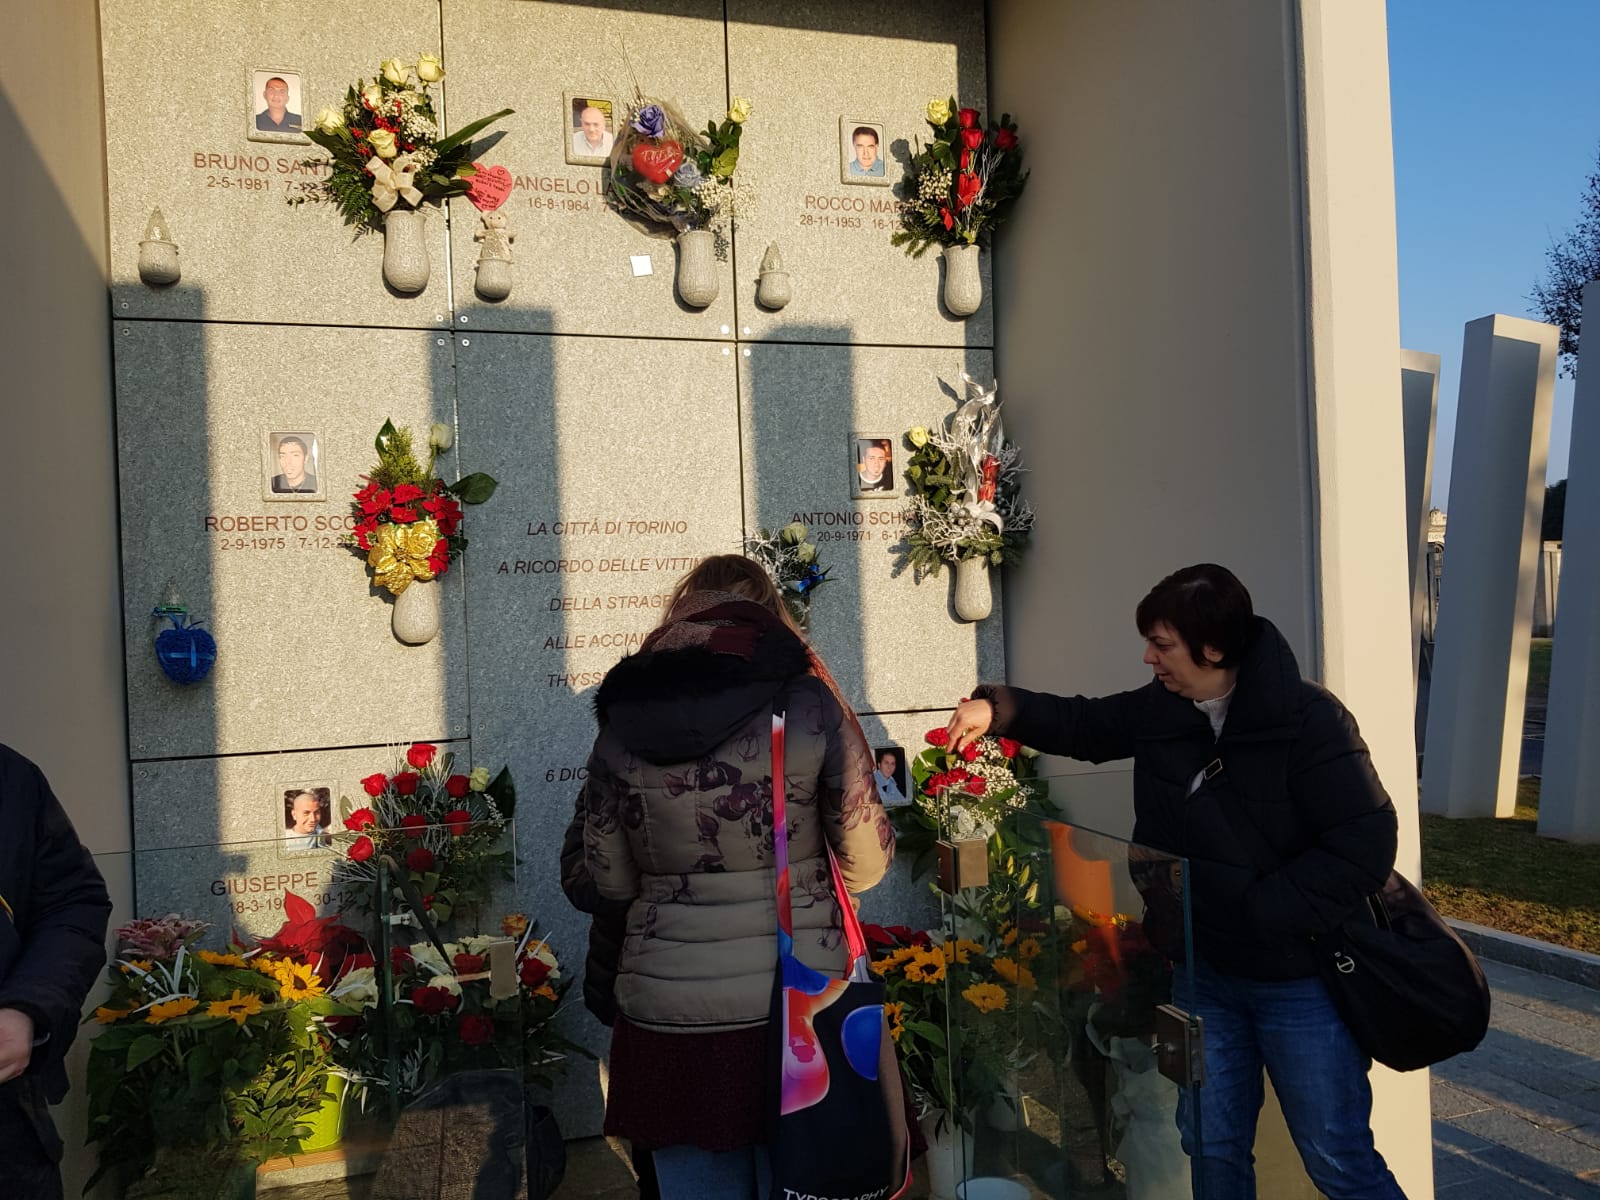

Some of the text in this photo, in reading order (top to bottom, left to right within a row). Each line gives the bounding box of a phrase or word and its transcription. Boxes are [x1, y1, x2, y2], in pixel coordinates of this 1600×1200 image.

[194, 152, 270, 172] BRUNO
[207, 175, 270, 191] 2-5-1981
[513, 175, 590, 195] ANGELO
[528, 198, 590, 212] 16-8-1964
[805, 195, 865, 213] ROCCO
[800, 214, 862, 229] 28-11-1953
[204, 516, 308, 532] ROBERTO
[792, 511, 864, 526] ANTONIO
[527, 522, 548, 535] LA
[605, 521, 621, 535] DI
[628, 520, 688, 534] TORINO
[817, 530, 871, 542] 20-9-1971
[221, 538, 285, 550] 2-9-1975
[497, 561, 510, 574] A
[514, 559, 594, 574] RICORDO
[599, 558, 650, 573] DELLE
[550, 597, 602, 612] DELLA
[543, 635, 586, 650] ALLE
[547, 671, 609, 688] THYSS
[545, 769, 555, 782] 6
[211, 872, 318, 896] GIUSEPPE
